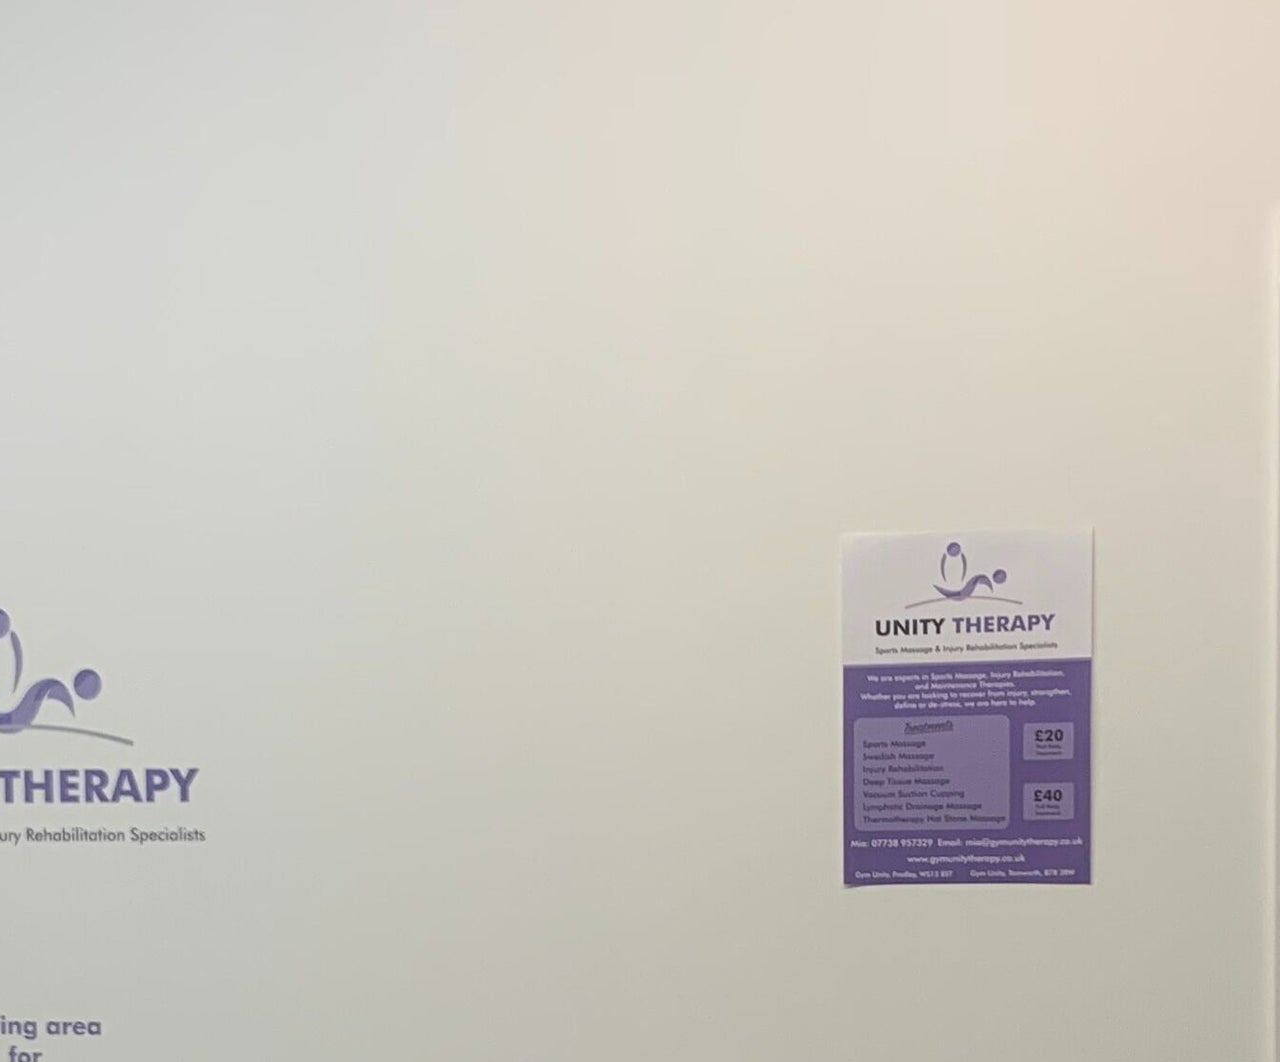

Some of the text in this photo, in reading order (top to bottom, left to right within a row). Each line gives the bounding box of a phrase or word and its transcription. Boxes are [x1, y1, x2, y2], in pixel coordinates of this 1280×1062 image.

[875, 614, 1056, 636] UNITY THERAPY
[875, 647, 898, 655] Sports
[900, 645, 933, 654] Massage
[943, 645, 963, 653] Injury
[966, 643, 1017, 651] Rehabilitation
[1020, 641, 1057, 651] Specialists
[1035, 729, 1064, 742] £20
[863, 740, 888, 748] Sports
[863, 778, 885, 786] Deep
[1034, 790, 1063, 802] £40
[26, 826, 126, 843] Rehabilitation
[130, 826, 206, 845] Specialists
[871, 839, 898, 847] 07738
[900, 838, 933, 847] 957329
[46, 1019, 102, 1036] area
